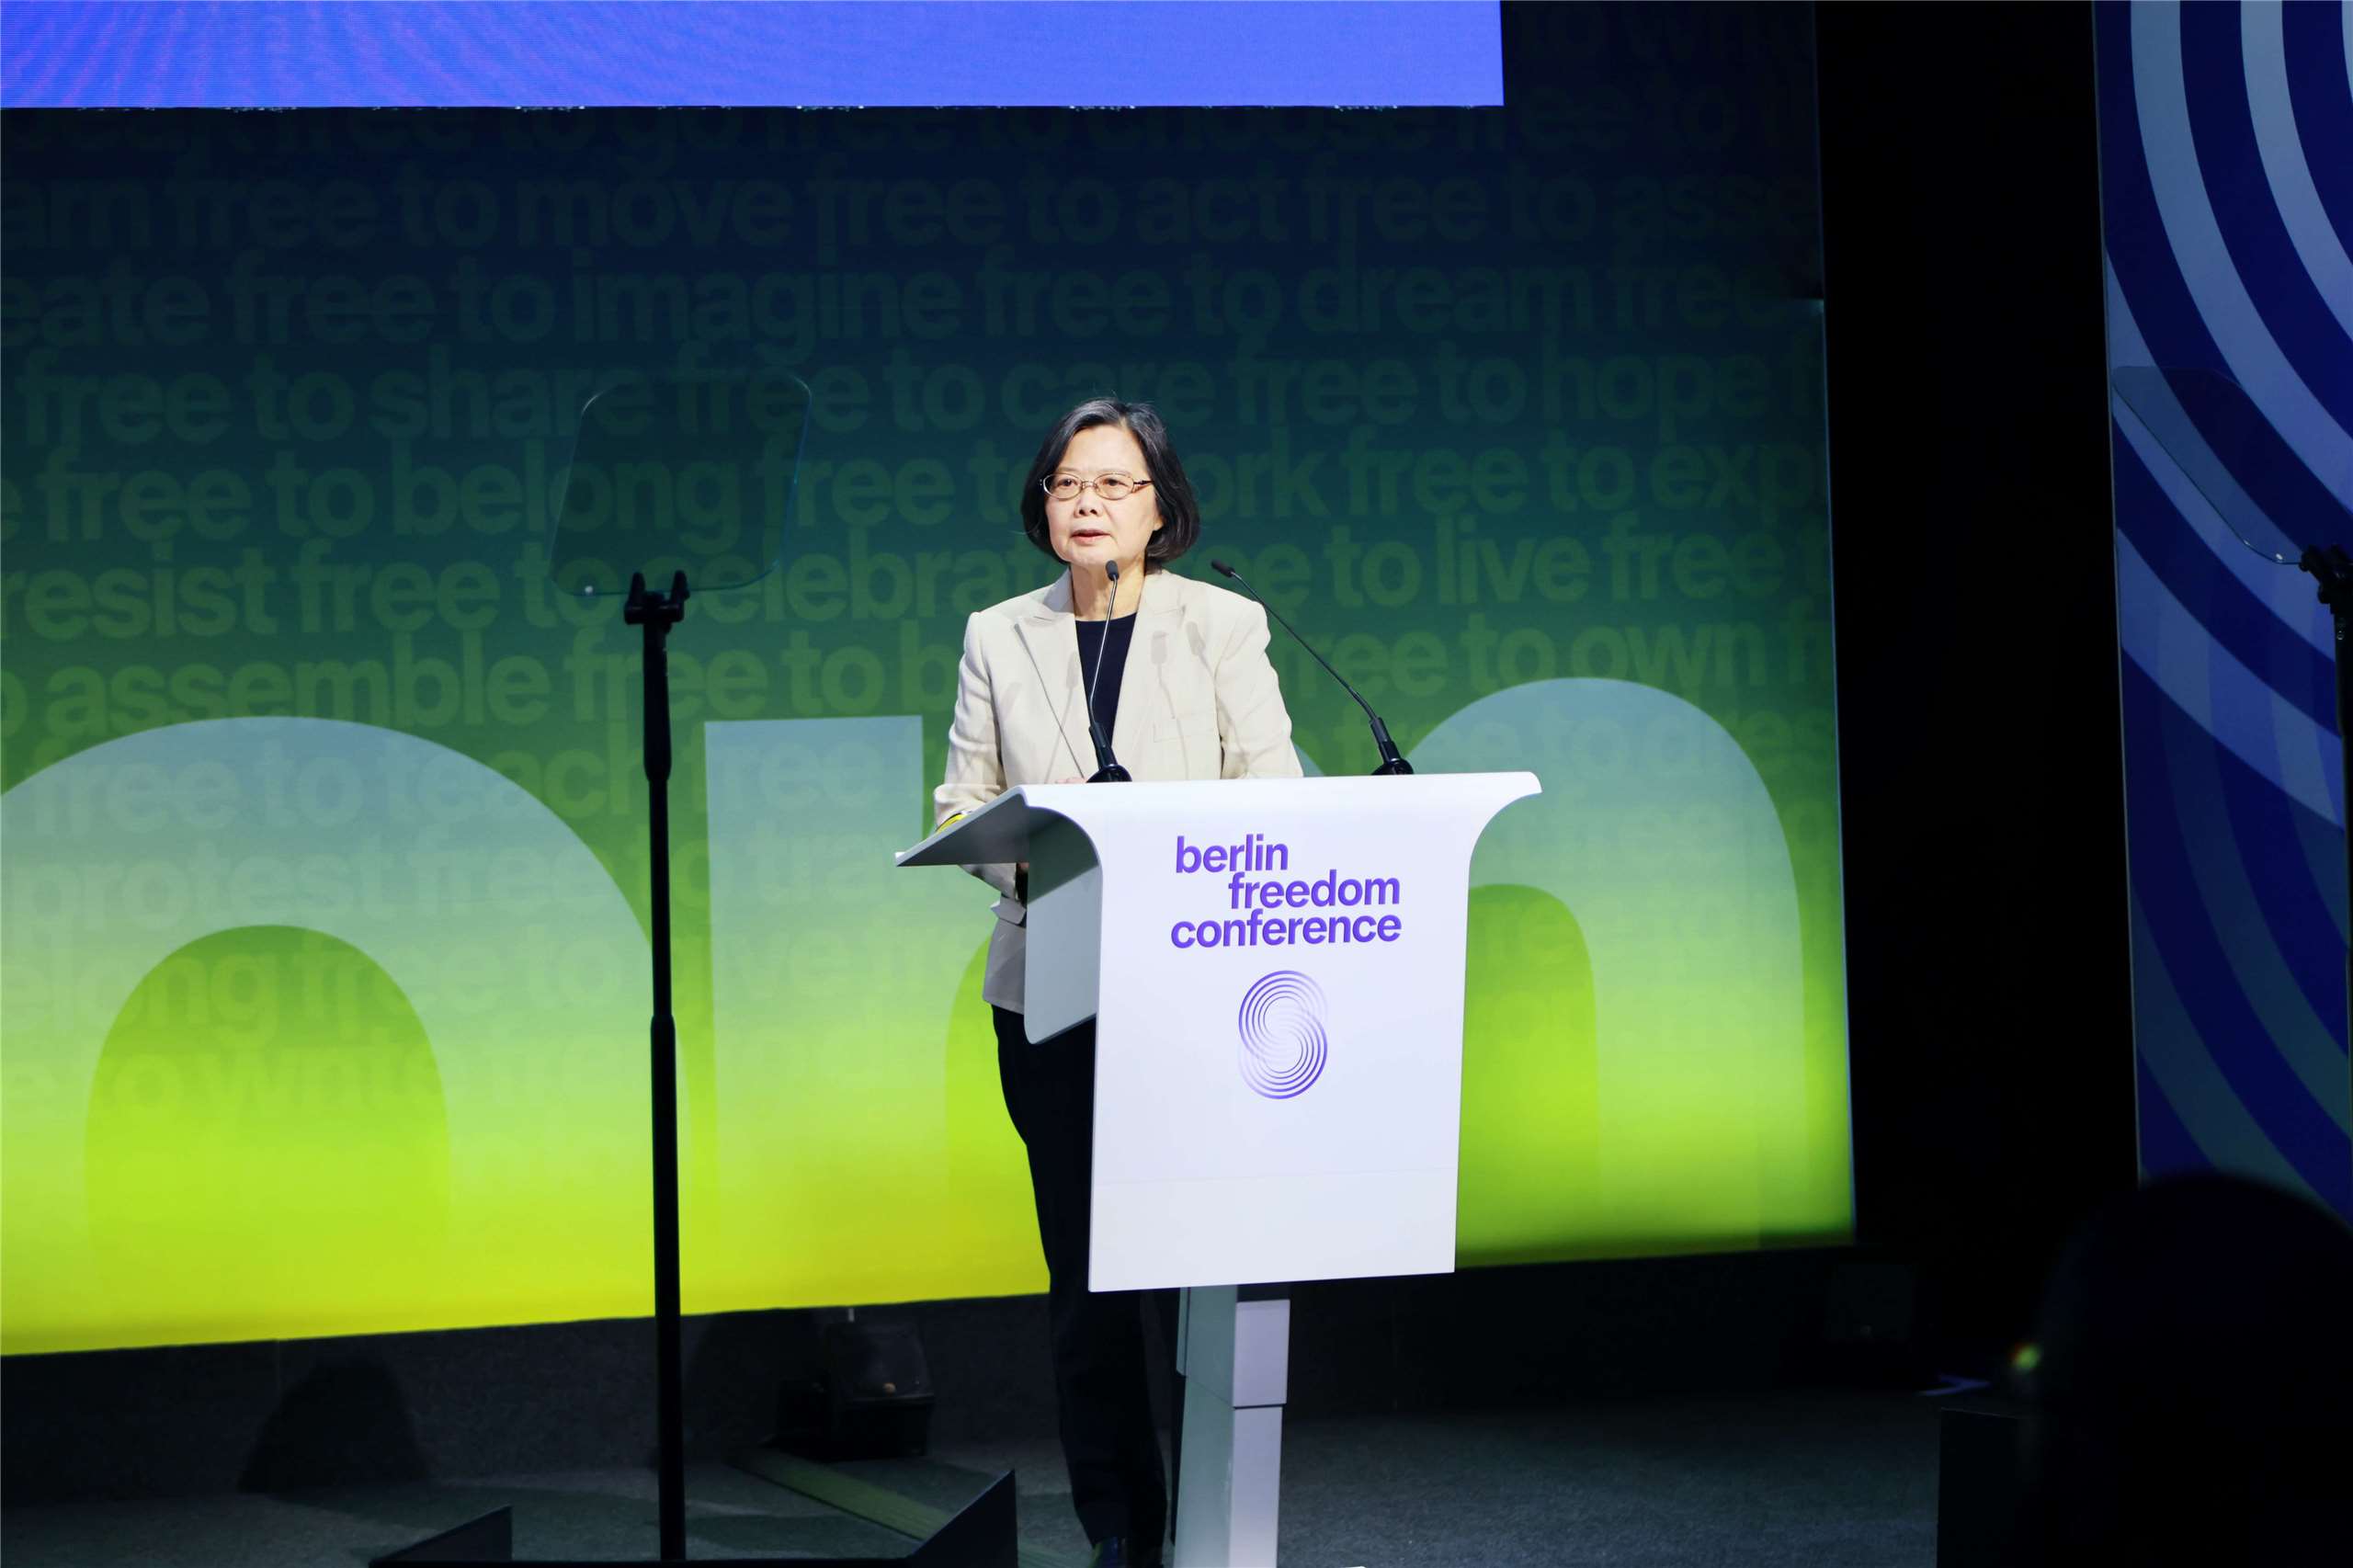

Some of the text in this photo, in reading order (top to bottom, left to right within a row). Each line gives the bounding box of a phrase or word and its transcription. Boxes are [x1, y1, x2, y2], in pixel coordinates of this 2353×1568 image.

[167, 150, 379, 249] free
[390, 159, 499, 249] to
[517, 176, 795, 248] move
[807, 151, 1009, 247] free
[1017, 160, 1121, 246] to
[1135, 160, 1290, 244] act
[1299, 152, 1486, 243] free
[1502, 157, 1597, 242] to
[222, 246, 436, 345] free
[449, 255, 556, 343] to
[572, 246, 962, 367] imagine
[974, 243, 1170, 339] free
[1183, 252, 1283, 337] to
[1296, 239, 1594, 335] dream
[14, 348, 234, 446] free
[249, 353, 356, 442] to
[368, 343, 655, 441] share
[668, 341, 871, 435] free
[882, 347, 986, 434] to
[1229, 334, 1420, 426] free
[1433, 340, 1529, 426] to
[1543, 327, 1770, 446] hope
[36, 446, 253, 543] free
[265, 451, 376, 540] to
[391, 438, 740, 555] belong
[754, 437, 957, 533] free
[1183, 425, 1332, 521] ork
[1340, 425, 1530, 517] free
[1540, 432, 1636, 513] to
[290, 539, 501, 634] free
[516, 540, 620, 631] to
[1324, 526, 1422, 608] to
[1437, 513, 1593, 607] live
[1602, 510, 1785, 603] free
[46, 628, 552, 738] assemble
[563, 625, 768, 723] free
[780, 630, 886, 716] to
[1460, 612, 1558, 694] to
[1569, 621, 1767, 695] own
[20, 738, 241, 835] free
[258, 737, 364, 829] to
[12, 829, 398, 945] protest
[1176, 834, 1289, 873] berlin
[1228, 869, 1400, 909] freedom
[1171, 908, 1402, 949] conference
